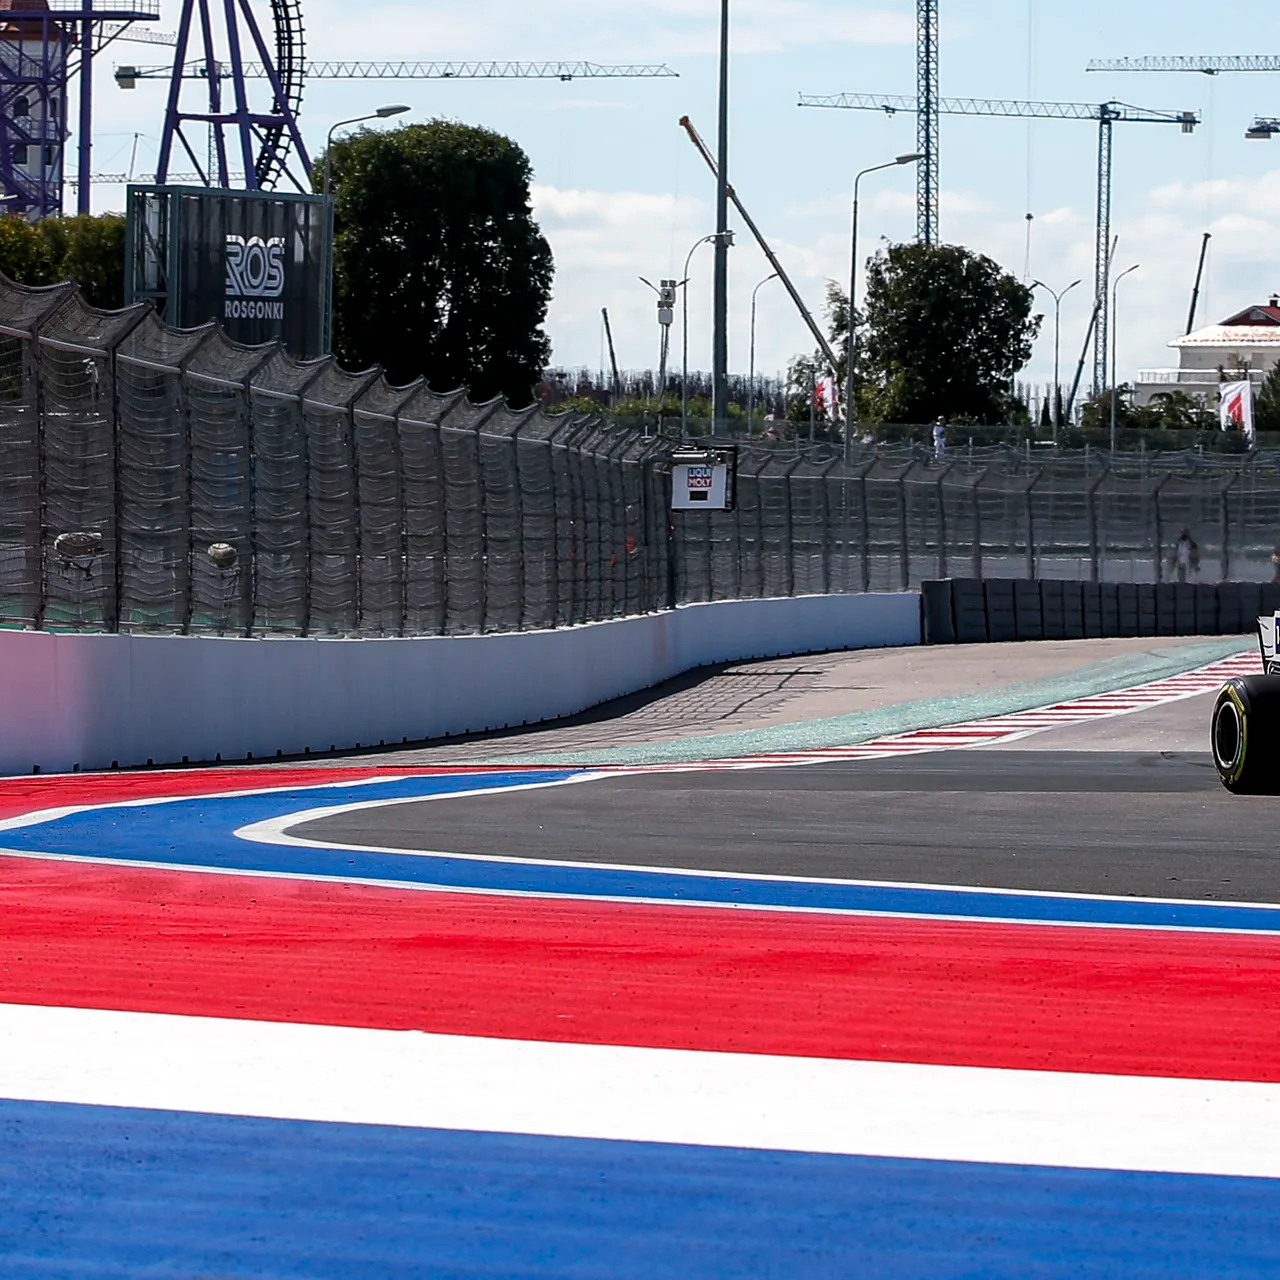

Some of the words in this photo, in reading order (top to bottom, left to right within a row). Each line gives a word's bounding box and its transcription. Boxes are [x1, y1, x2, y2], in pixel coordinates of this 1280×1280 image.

[225, 234, 286, 297] ROS
[224, 300, 284, 320] ROSGONKI
[689, 468, 711, 478] LIQUI
[688, 478, 712, 487] MOLY
